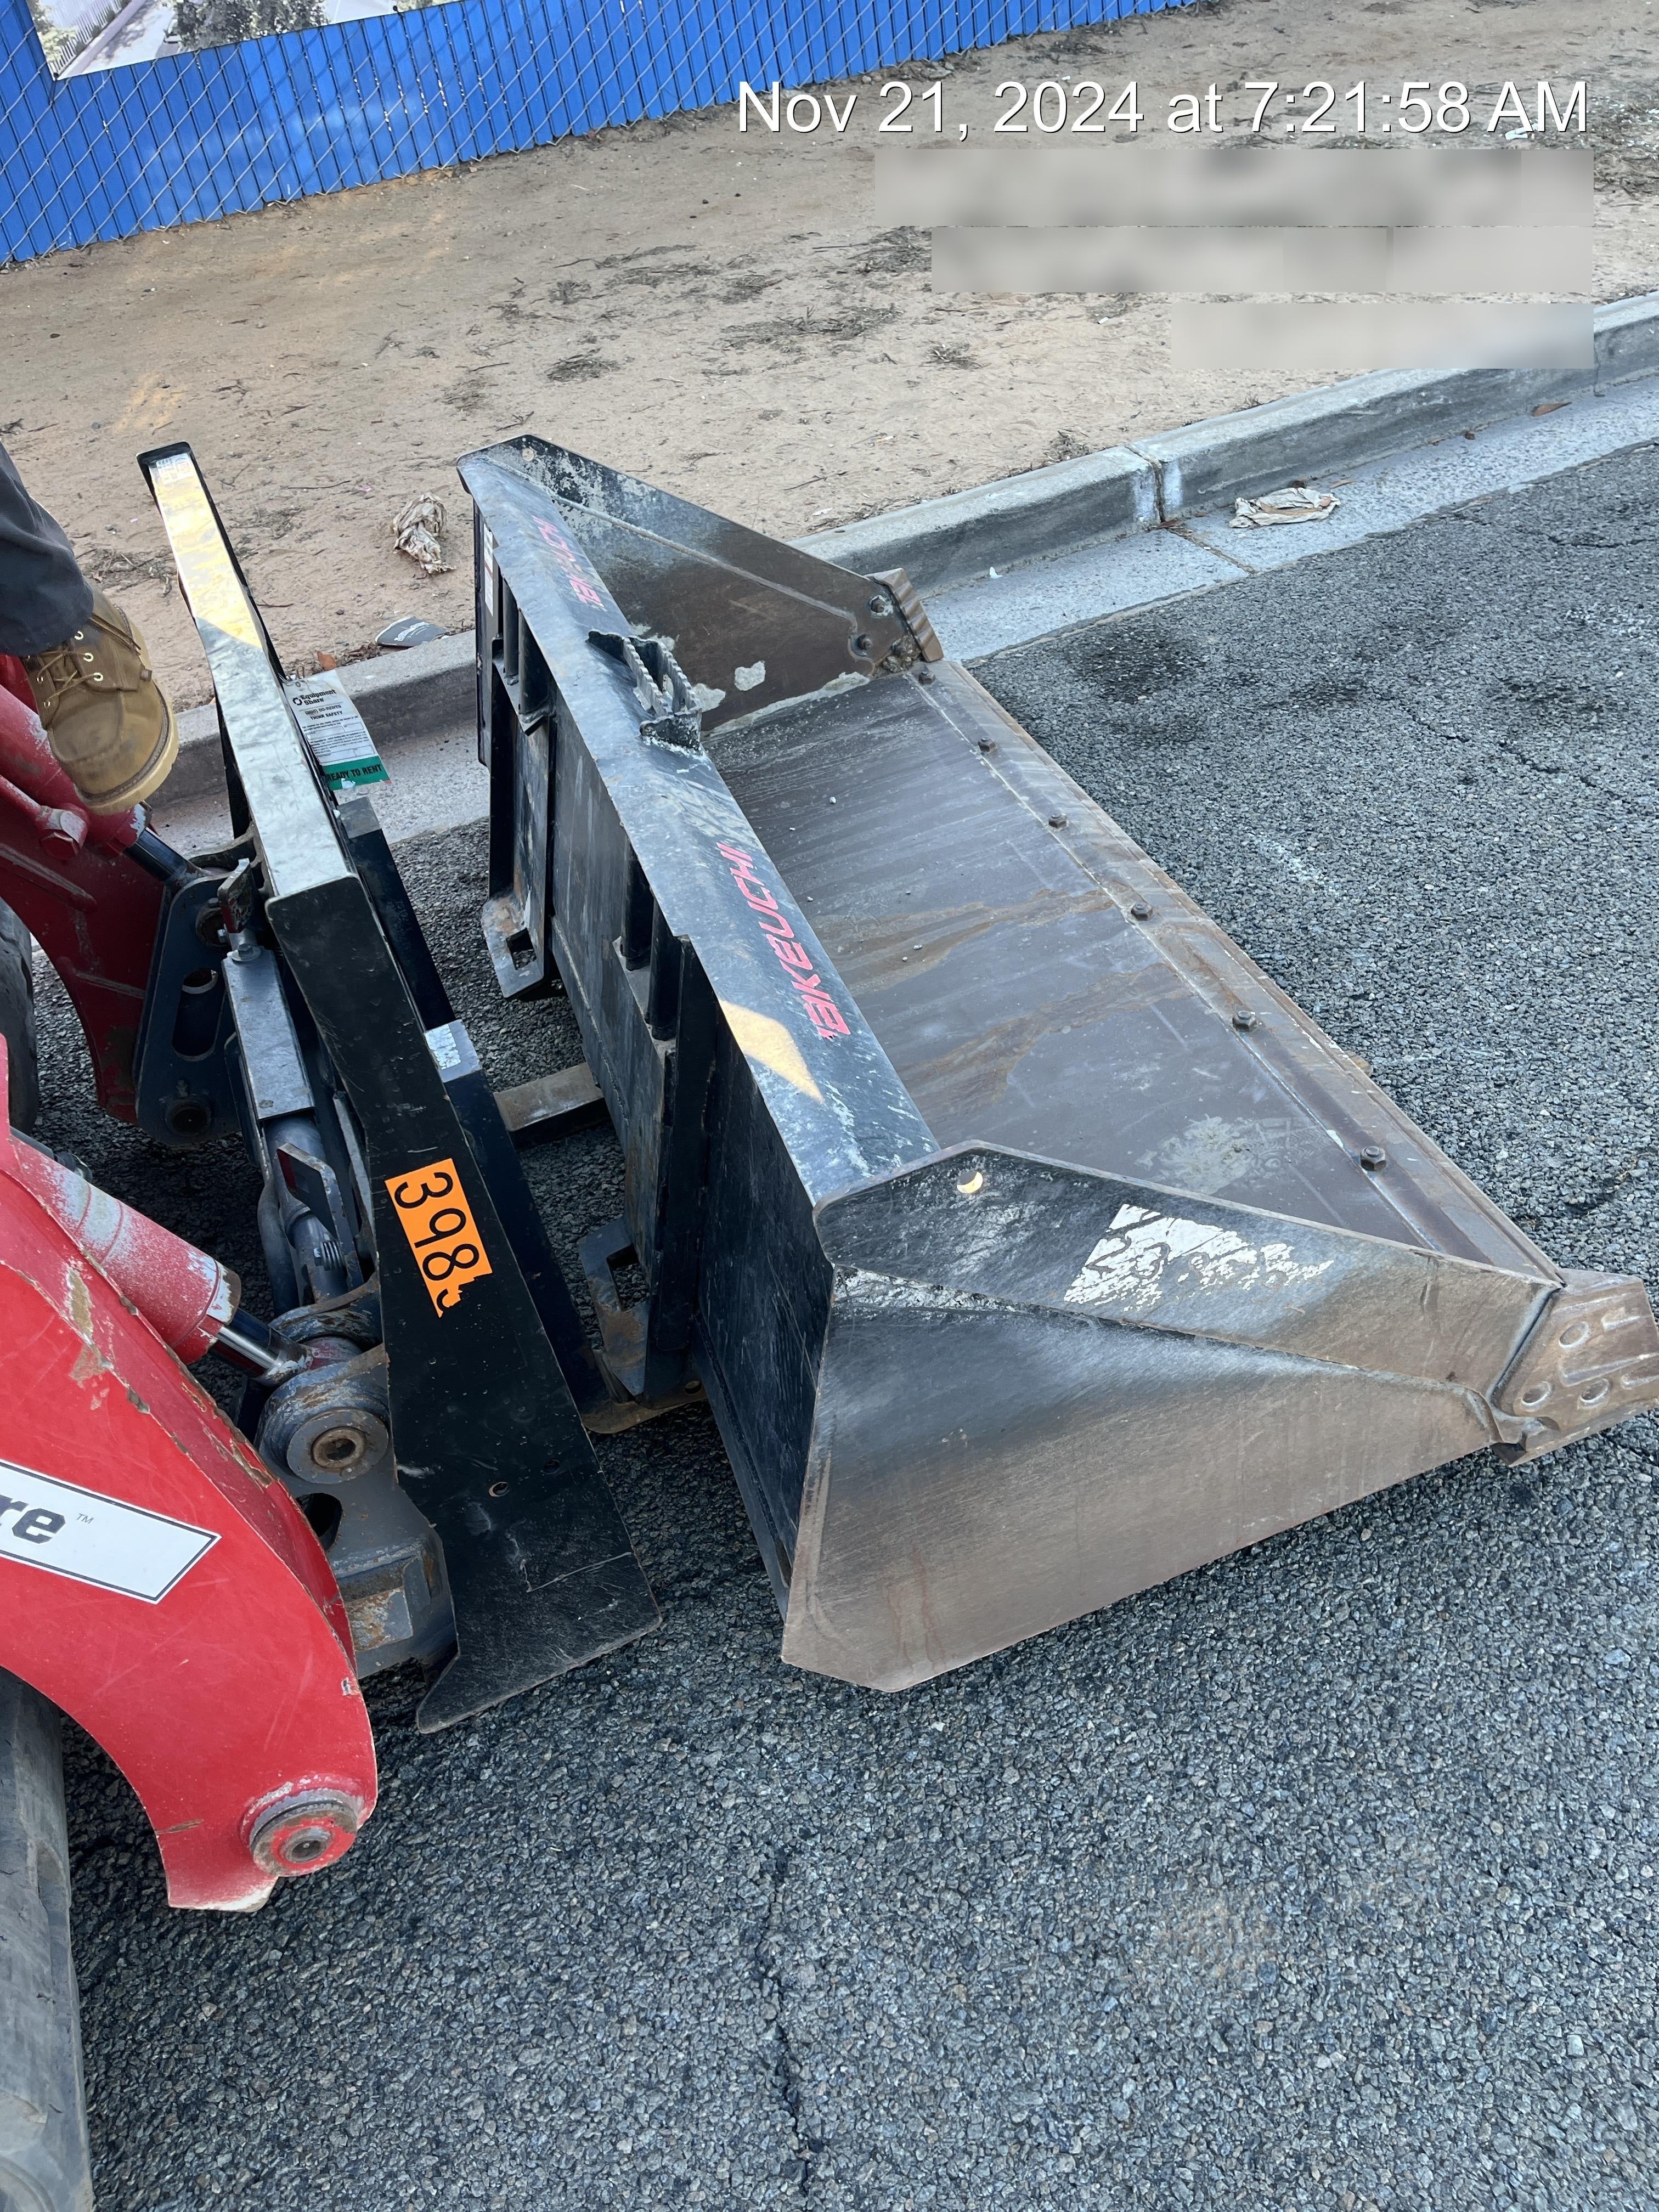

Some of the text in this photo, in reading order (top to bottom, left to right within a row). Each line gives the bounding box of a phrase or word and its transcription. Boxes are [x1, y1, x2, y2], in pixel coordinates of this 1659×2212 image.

[300, 689, 337, 700] Equipment
[328, 764, 382, 781] READY TO RENT
